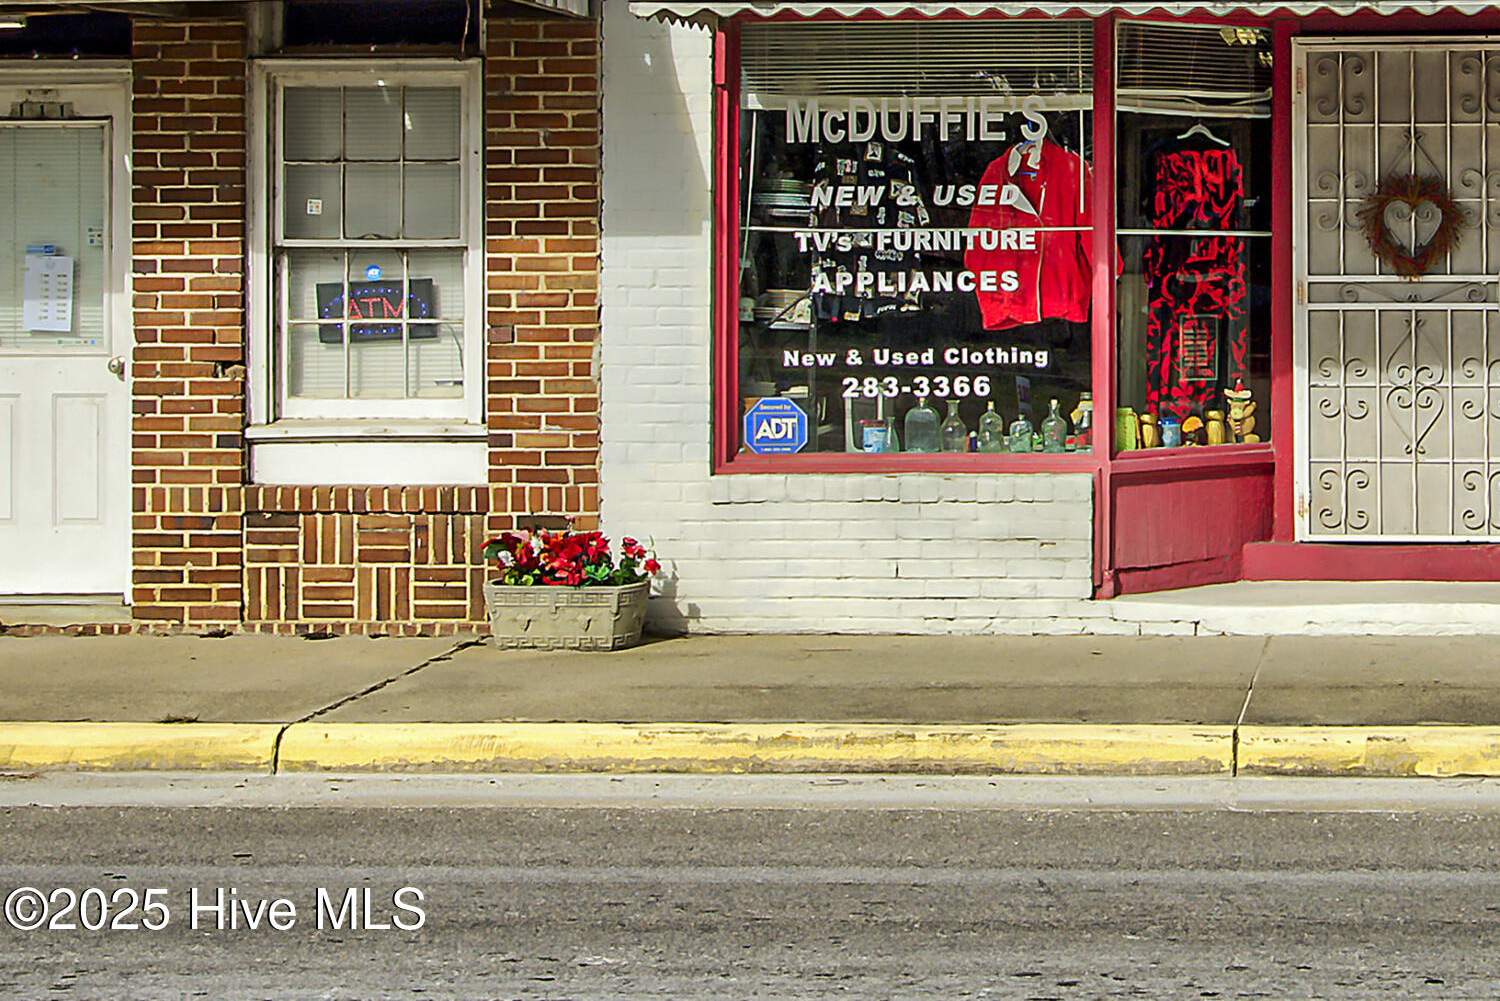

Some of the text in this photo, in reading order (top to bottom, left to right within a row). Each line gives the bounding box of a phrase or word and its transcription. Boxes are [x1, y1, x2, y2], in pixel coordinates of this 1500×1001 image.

[786, 95, 1048, 143] McDUFFIE'S
[811, 184, 1019, 207] NEW & USED
[794, 231, 852, 252] TV's
[877, 230, 1036, 251] FURNITURE
[811, 271, 1019, 292] APPLIANCES
[345, 297, 406, 319] ATM
[783, 348, 1049, 368] New & Used Clothing
[842, 376, 991, 398] 283-3366
[755, 417, 798, 440] ADT
